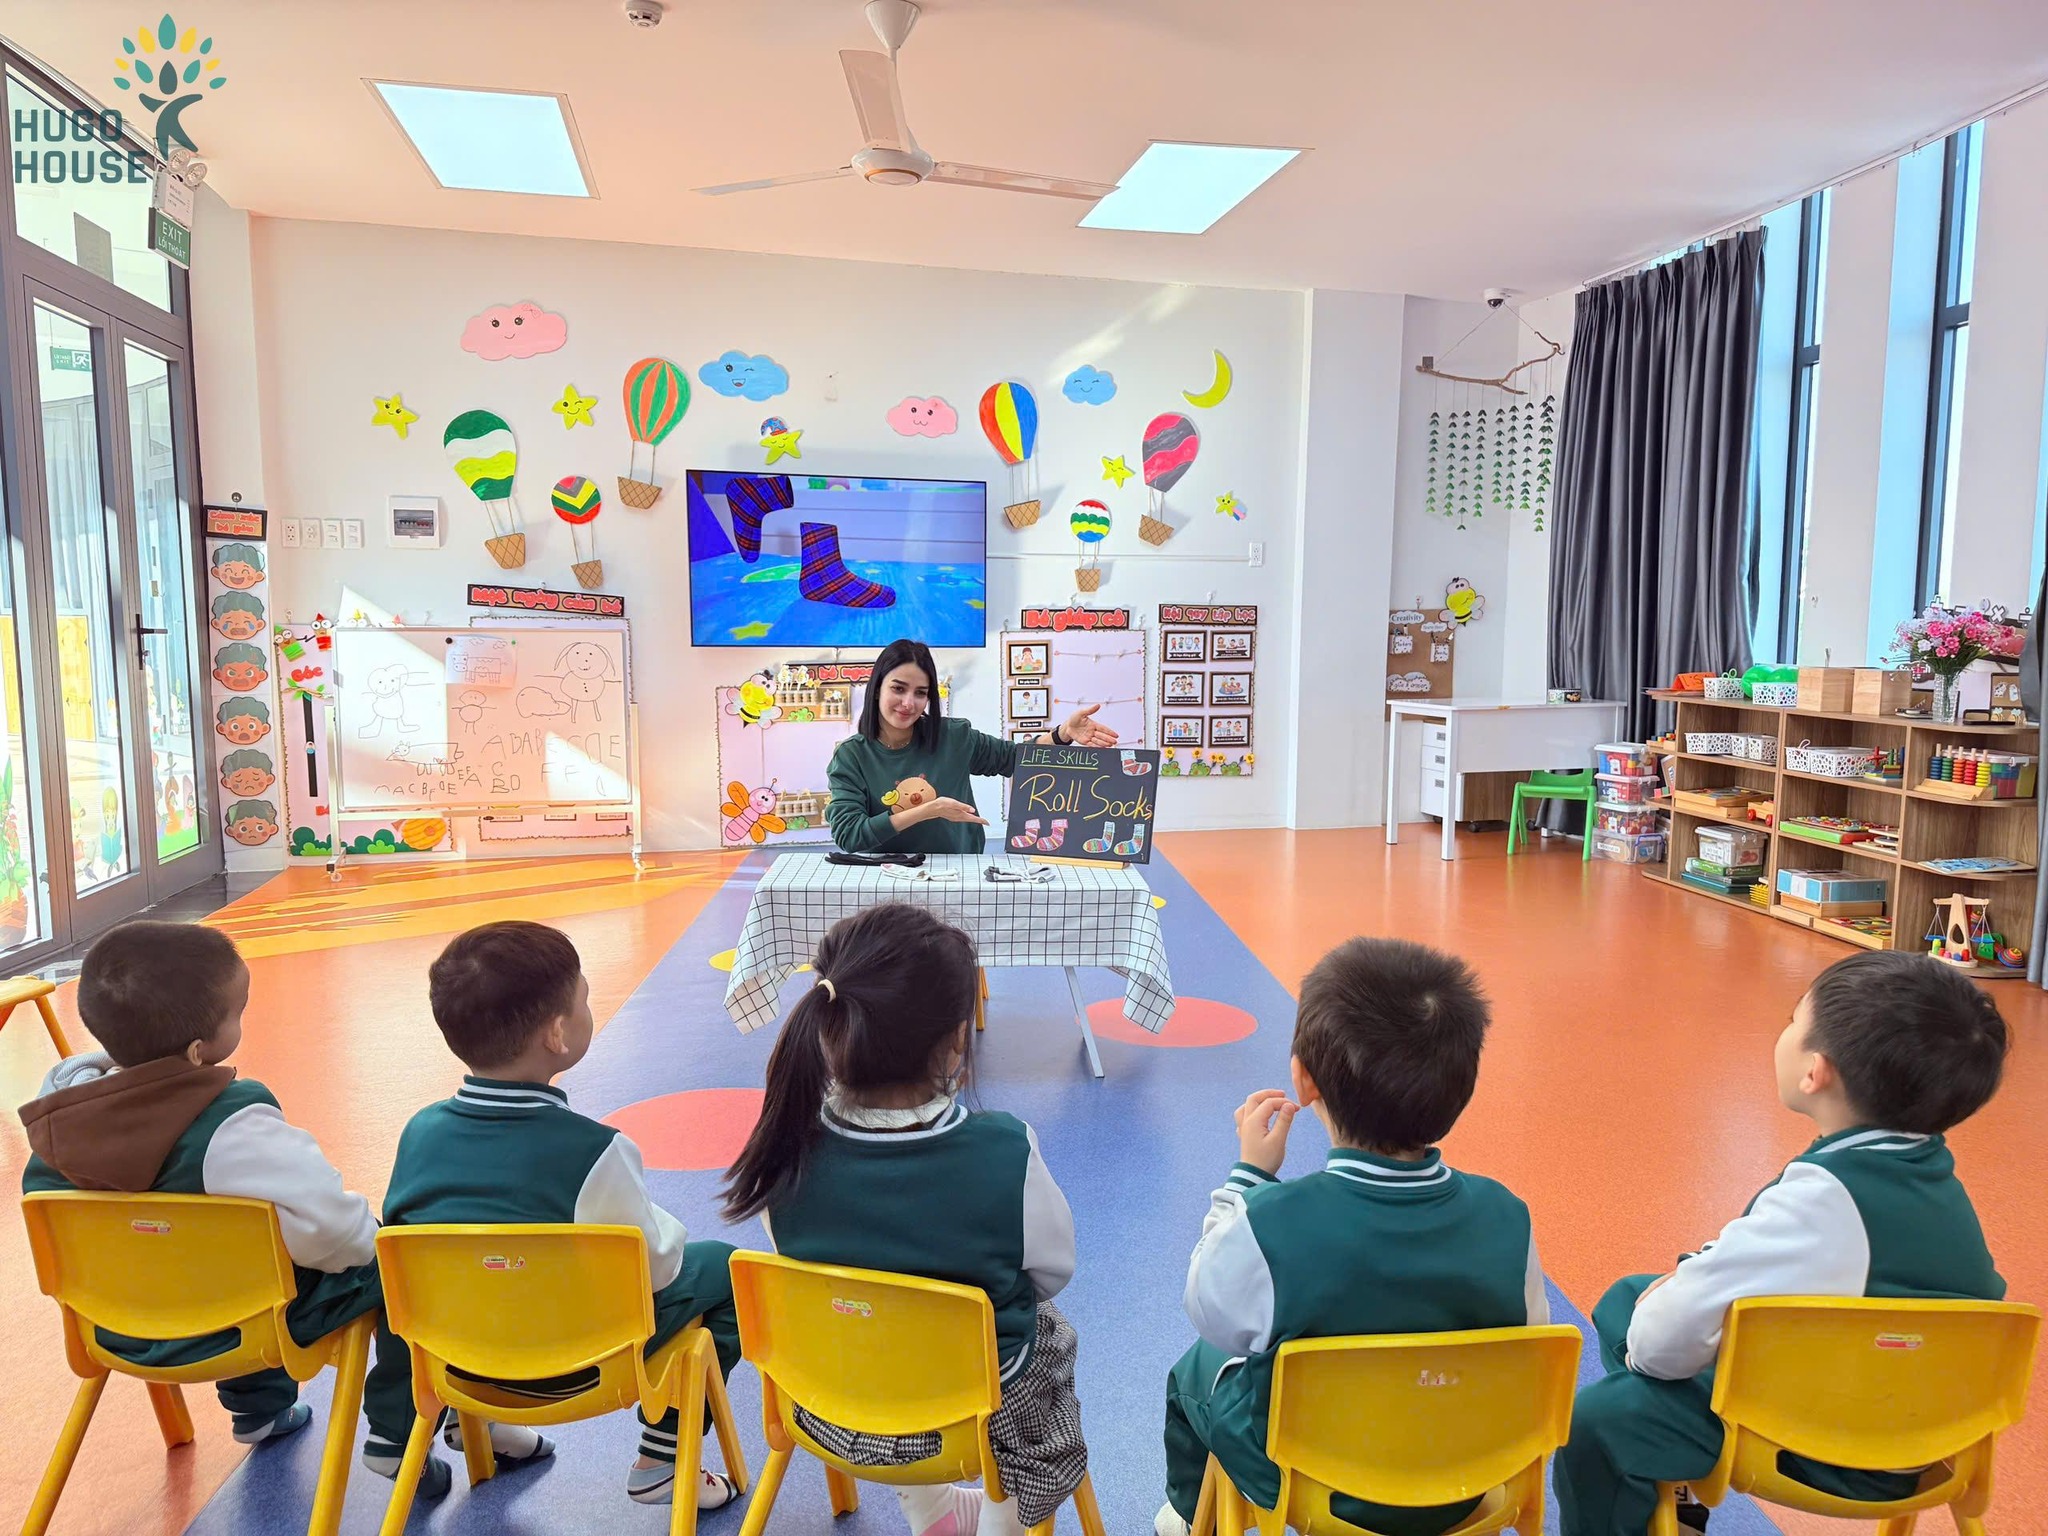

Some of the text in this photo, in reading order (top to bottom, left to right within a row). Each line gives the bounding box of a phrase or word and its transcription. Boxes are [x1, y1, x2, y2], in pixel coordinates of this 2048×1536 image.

[162, 221, 182, 244] EXIT
[168, 242, 186, 260] THOÁT
[513, 590, 559, 609] ngày
[600, 598, 622, 613] bé
[1025, 607, 1125, 631] Bé giúp cô
[291, 665, 323, 682] Góc
[1021, 747, 1099, 767] LIFE SKILLS
[1019, 773, 1153, 820] Roll Socks
